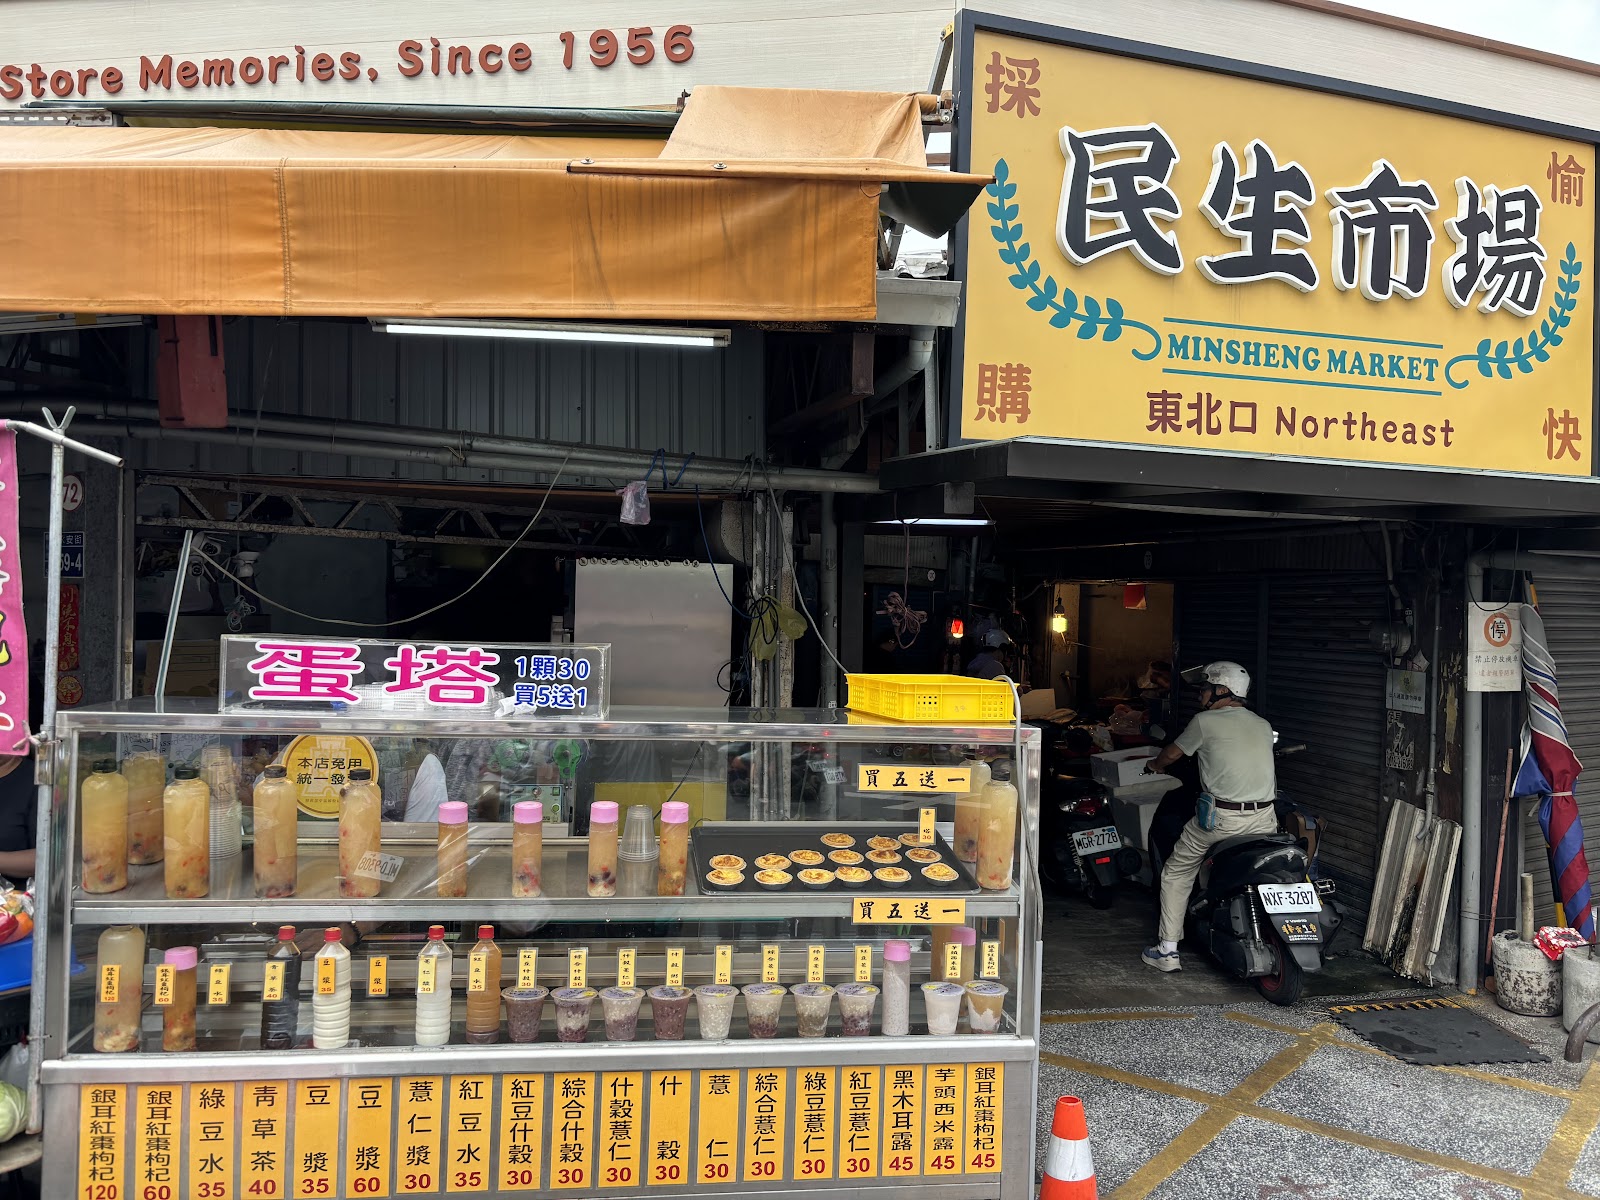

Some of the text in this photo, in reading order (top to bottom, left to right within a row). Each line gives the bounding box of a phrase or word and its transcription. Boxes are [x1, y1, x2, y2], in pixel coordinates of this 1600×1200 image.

[0, 24, 695, 99] Store Memories, Since 1956
[985, 51, 1041, 118] 採
[1056, 122, 1547, 318] 民生市場
[1547, 151, 1586, 207] 愉
[974, 363, 1032, 424] 購
[1167, 333, 1440, 382] MINSHENG MARKET
[1146, 390, 1455, 448] 東北口 Northeast
[1542, 407, 1582, 461] 快
[247, 642, 500, 704] 蛋塔
[514, 655, 592, 679] 1顆30
[1490, 620, 1506, 639] 停
[514, 683, 589, 707] 買5送1
[297, 773, 350, 785] 統一發
[865, 768, 966, 789] 買五送一
[1076, 831, 1119, 850] MGR-2728
[859, 901, 961, 920] 買五送一
[1262, 890, 1315, 906] NXF-3287
[85, 1088, 117, 1200] 銀耳紅棗枸杞 120
[144, 1090, 172, 1200] 銀耳紅棗枸杞 60
[198, 1088, 225, 1198] 綠豆水 35
[249, 1086, 278, 1195] 青草茶 40
[302, 1086, 330, 1193] 豆漿 35
[353, 1085, 382, 1193] 豆漿 60
[404, 1081, 434, 1189] 薏仁漿 30
[455, 1080, 483, 1187] 紅豆水 35
[507, 1079, 535, 1185] 紅豆什穀 30
[558, 1078, 586, 1183] 綜合什穀 30
[606, 1077, 633, 1182] 什穀薏仁 30
[655, 1076, 682, 1180] 什穀 30
[704, 1075, 730, 1178] 薏仁 30
[751, 1073, 778, 1176] 綜合薏仁 30
[801, 1072, 827, 1174] 綠豆薏仁 30
[846, 1071, 871, 1173] 紅豆薏仁 30
[889, 1070, 914, 1171] 黑木耳露 45
[931, 1069, 956, 1170] 芋頭西米露 45
[972, 1067, 996, 1168] 銀耳紅棗枸杞 45
